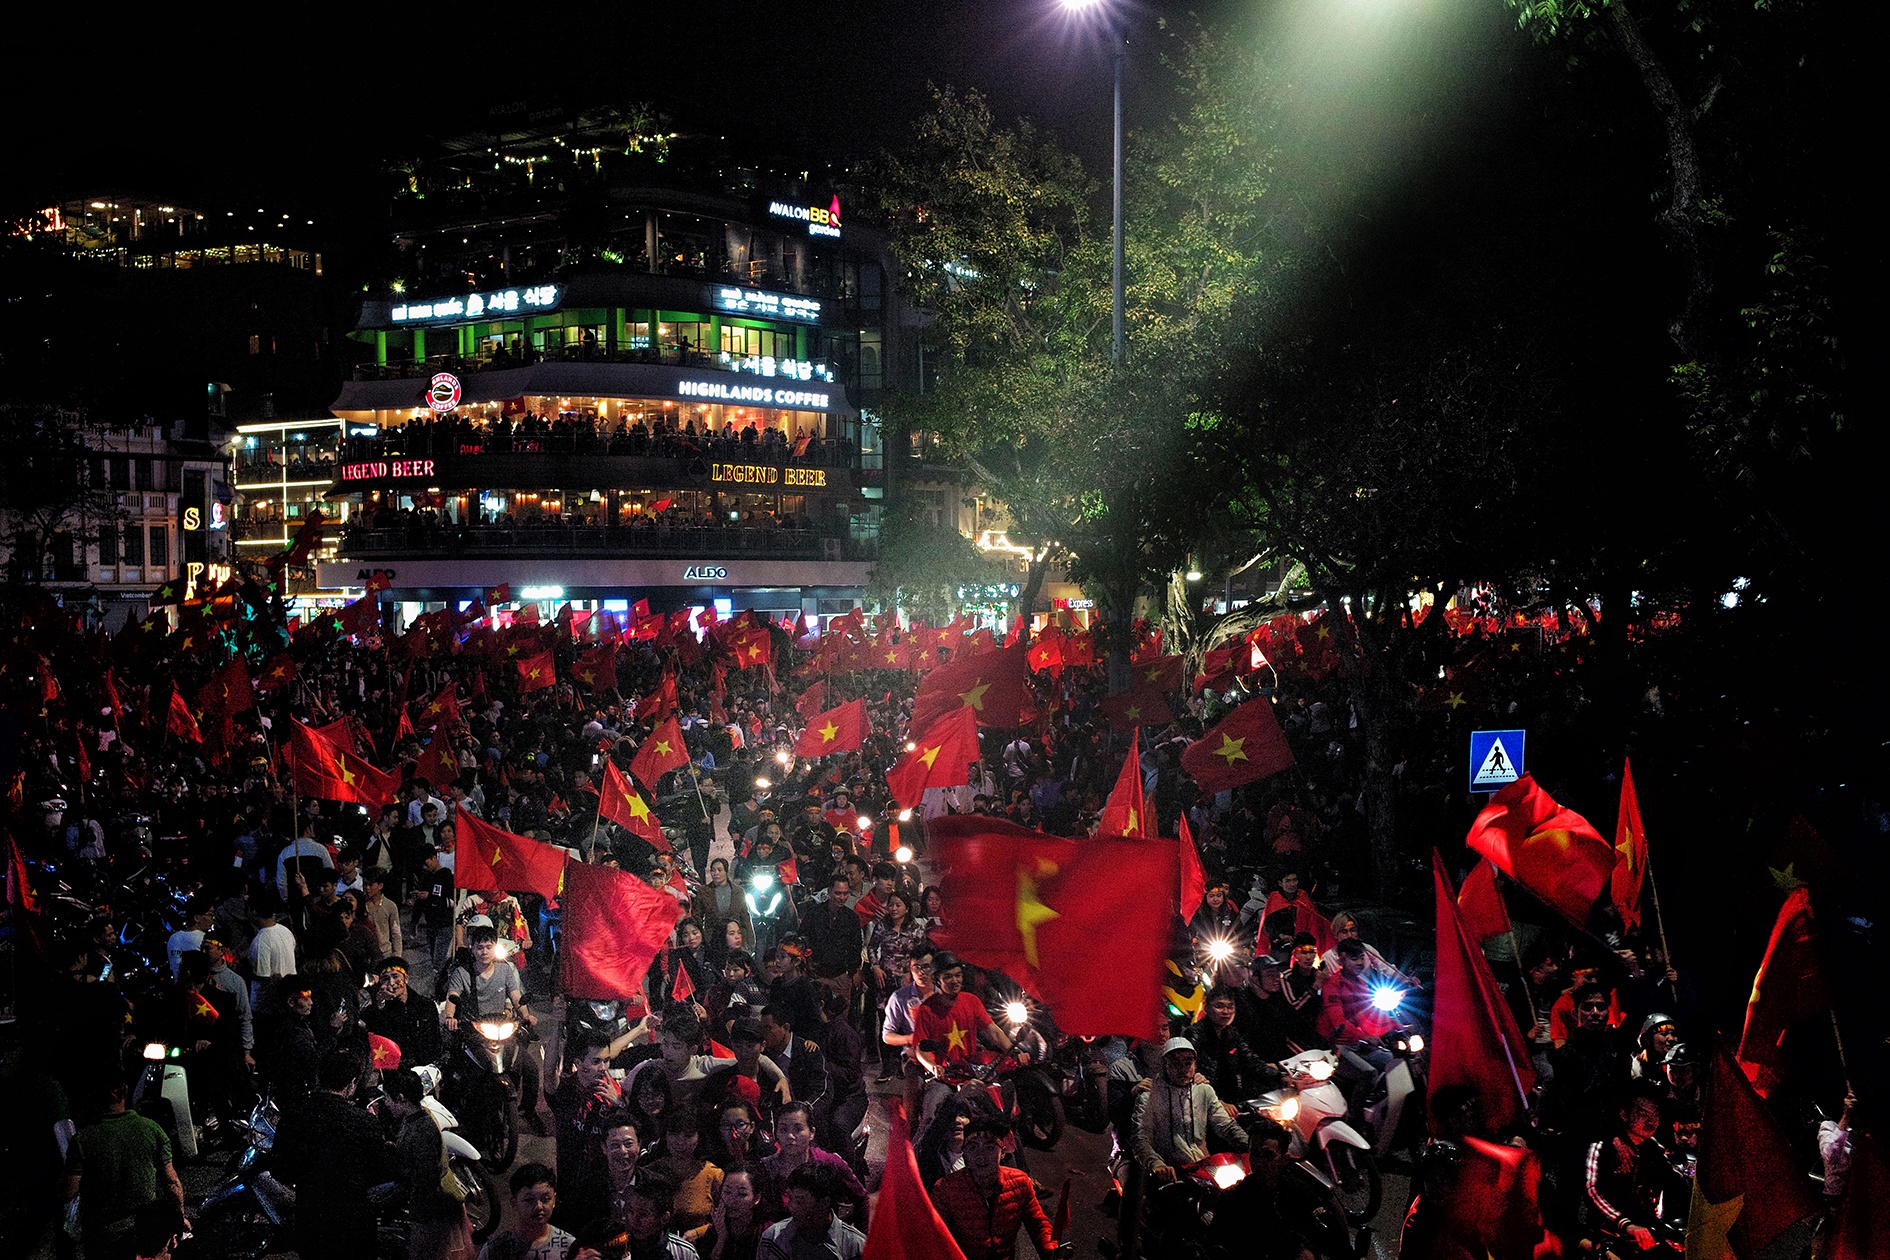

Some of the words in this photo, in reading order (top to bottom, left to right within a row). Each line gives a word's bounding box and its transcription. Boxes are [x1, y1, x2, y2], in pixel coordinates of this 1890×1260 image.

[769, 201, 810, 221] AVALON
[742, 356, 777, 377] 서울
[781, 359, 814, 380] 식당
[679, 381, 773, 403] HIGHLANDS
[774, 389, 829, 408] COFFEE
[341, 462, 388, 481] LEGEND
[392, 460, 435, 478] BEER
[711, 463, 779, 485] LEGEND
[784, 467, 827, 487] BEER
[683, 565, 728, 581] ALDO
